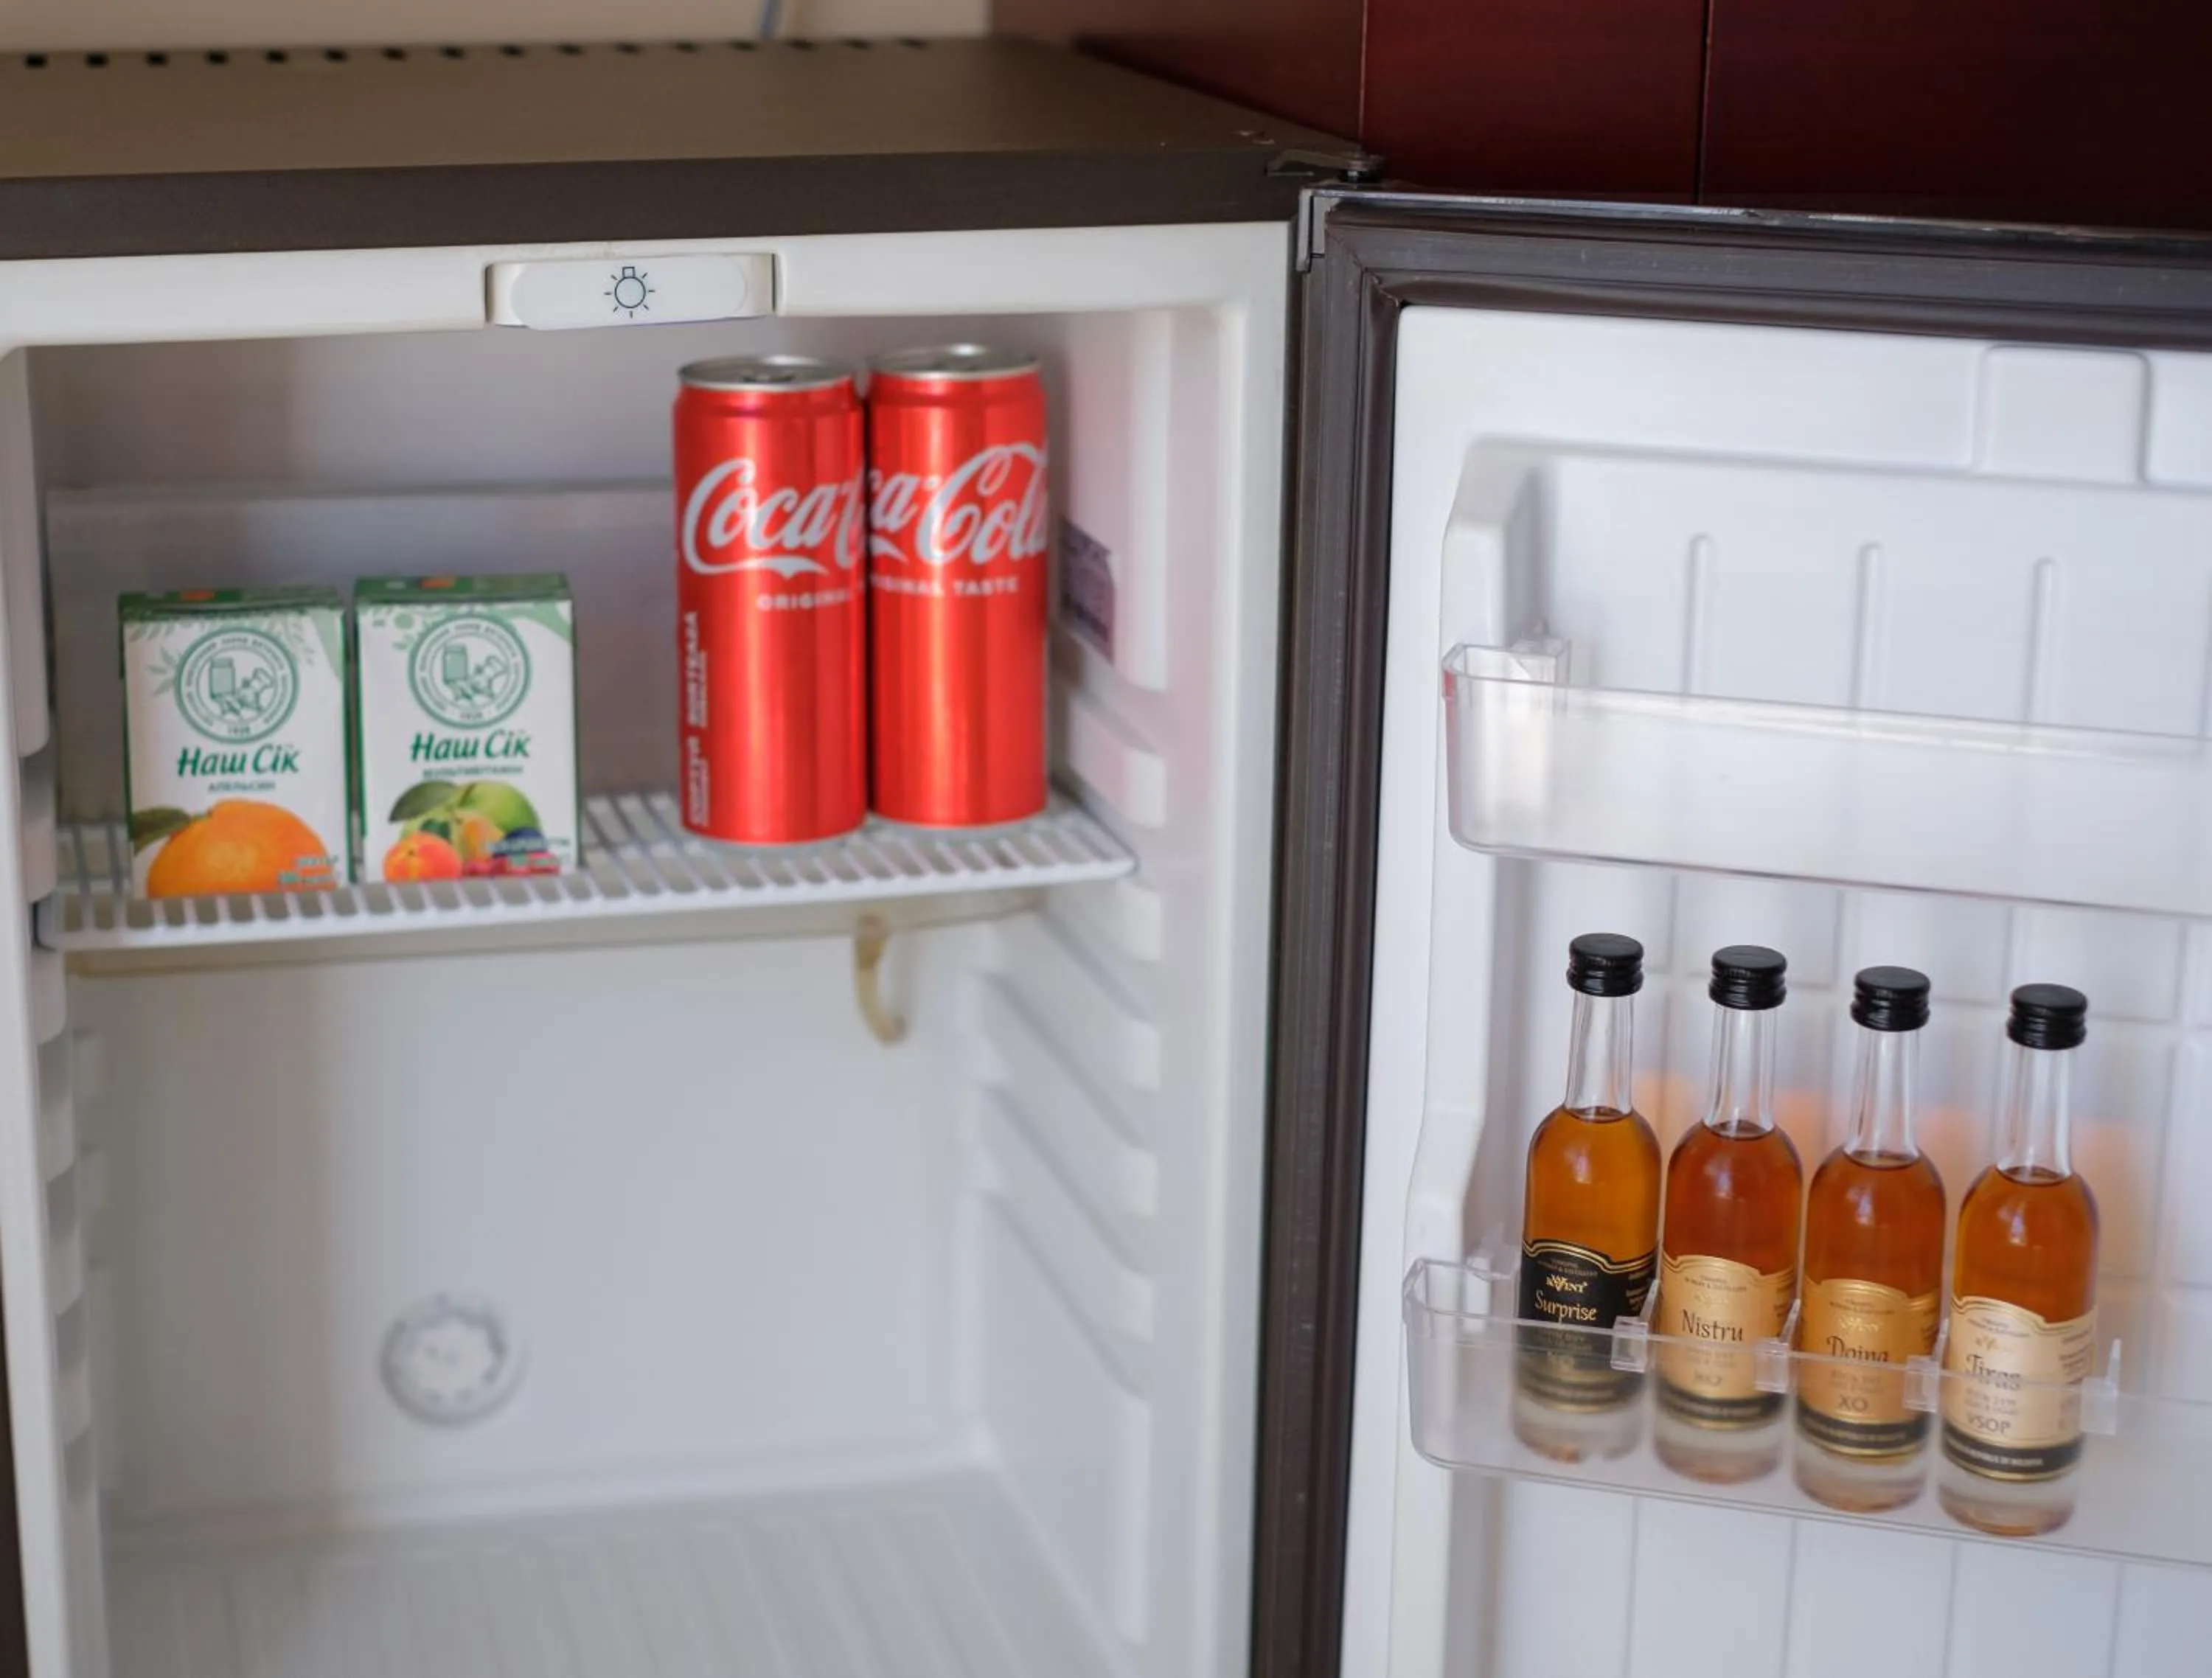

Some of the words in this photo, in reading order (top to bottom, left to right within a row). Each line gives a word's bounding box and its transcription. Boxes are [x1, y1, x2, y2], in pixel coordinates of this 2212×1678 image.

[953, 575, 1020, 596] TASTE
[177, 746, 247, 778] Наш
[252, 743, 299, 773] Сік
[411, 731, 479, 761] Наш
[484, 728, 532, 758] Сік
[1534, 1289, 1597, 1324] Surprise
[1682, 1309, 1744, 1342] Nistru
